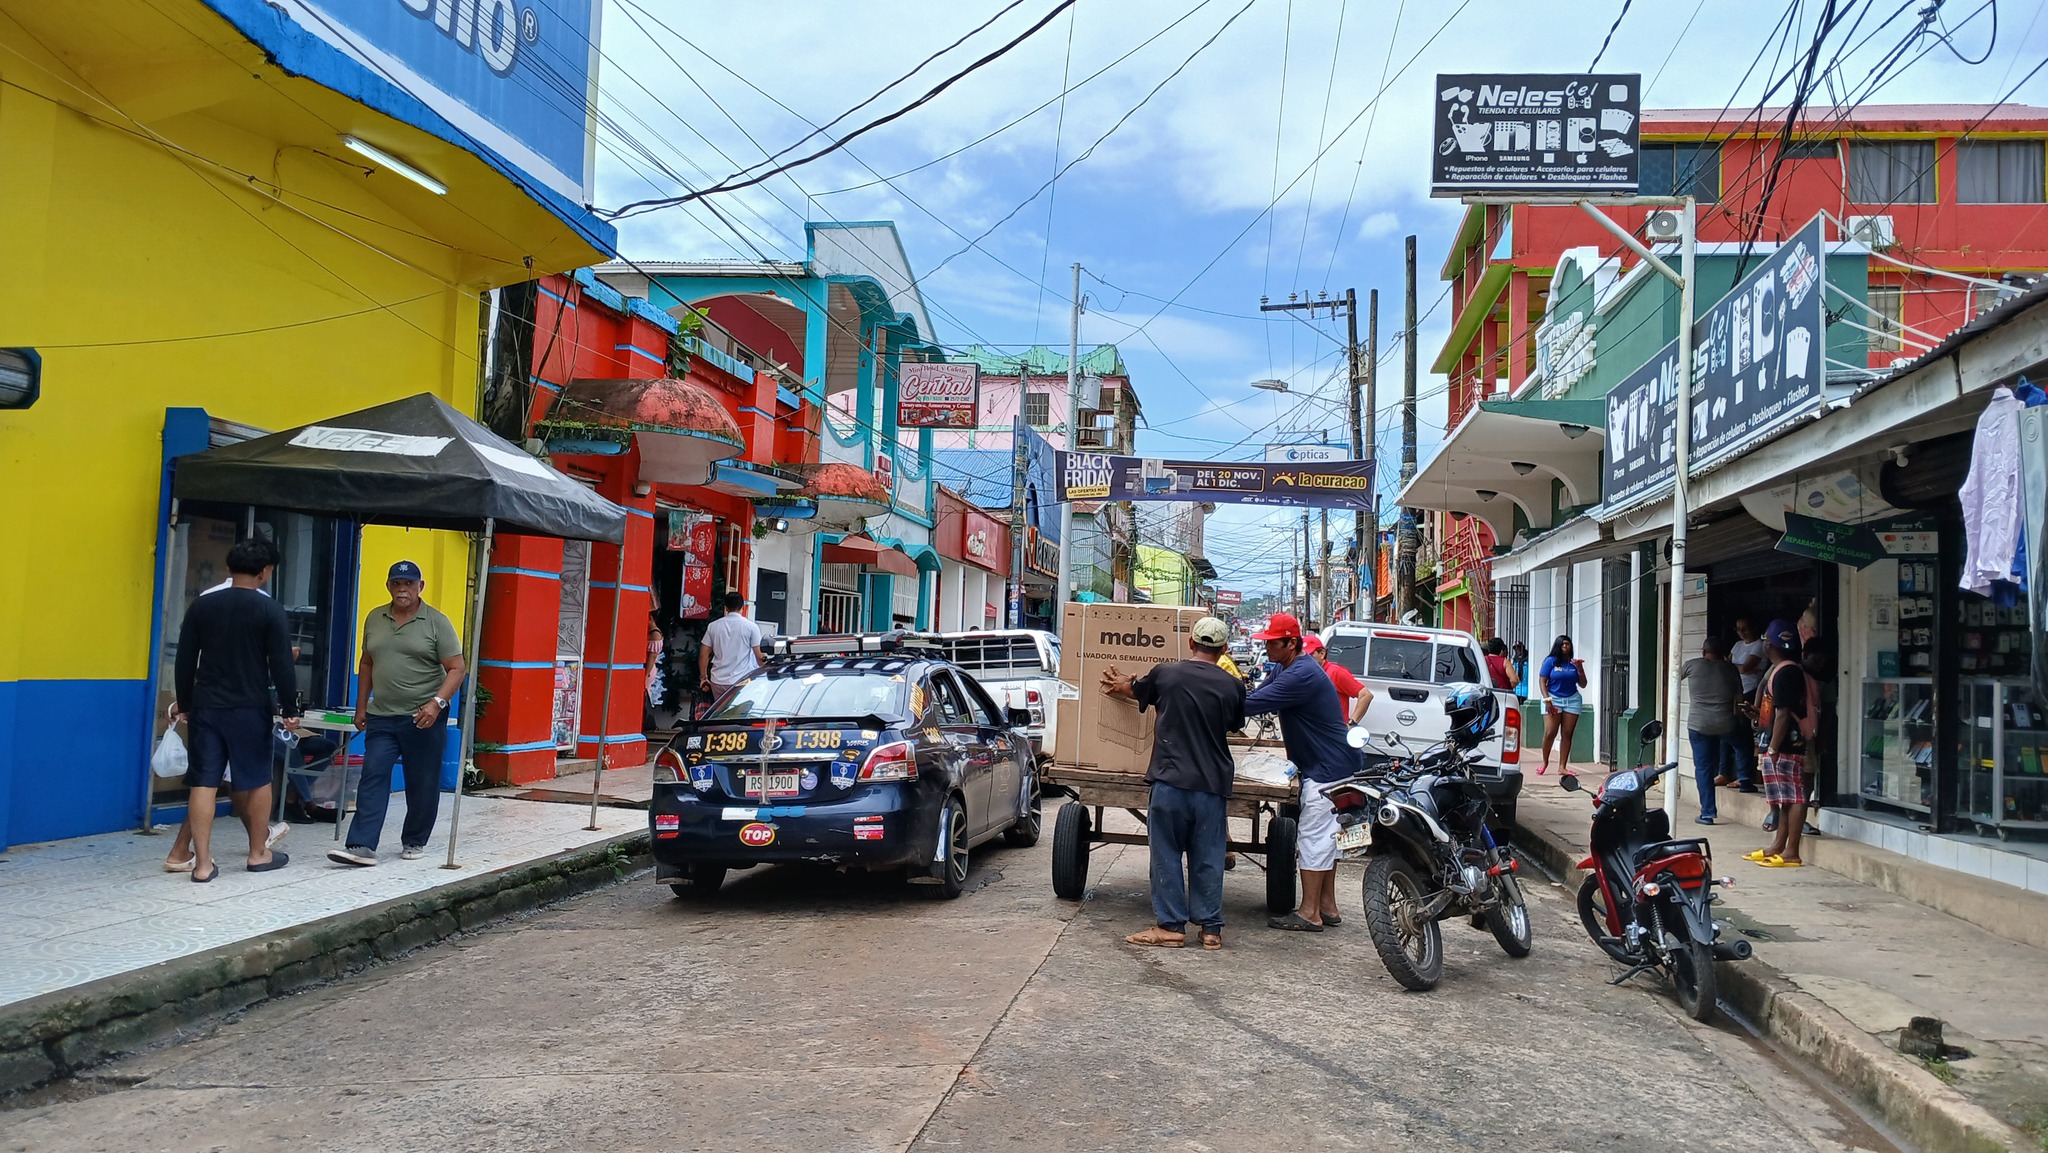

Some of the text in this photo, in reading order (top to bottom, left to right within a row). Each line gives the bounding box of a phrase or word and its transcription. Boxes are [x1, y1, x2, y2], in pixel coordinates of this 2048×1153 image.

[1476, 81, 1599, 106] Neles Cel
[1519, 107, 1561, 115] CELULARES
[1449, 165, 1485, 173] Repuestos
[1451, 173, 1492, 181] Reparación
[1547, 173, 1591, 181] Desbloqueo
[1710, 301, 1732, 346] Cel
[901, 374, 973, 401] Central
[1725, 421, 1747, 441] celulares
[1752, 400, 1782, 427] Desbloqueo
[1786, 384, 1809, 406] Flasheo
[1066, 453, 1112, 470] BLACK
[1064, 469, 1114, 487] FRIDAY
[1197, 470, 1261, 480] DEL 20 NOV.
[1298, 472, 1367, 490] la curacao
[1196, 479, 1241, 488] AL 1 DIC.
[1100, 627, 1165, 649] mabe
[1076, 651, 1117, 661] LAVADORA
[751, 776, 793, 790] RS 1900
[744, 829, 772, 842] TOP
